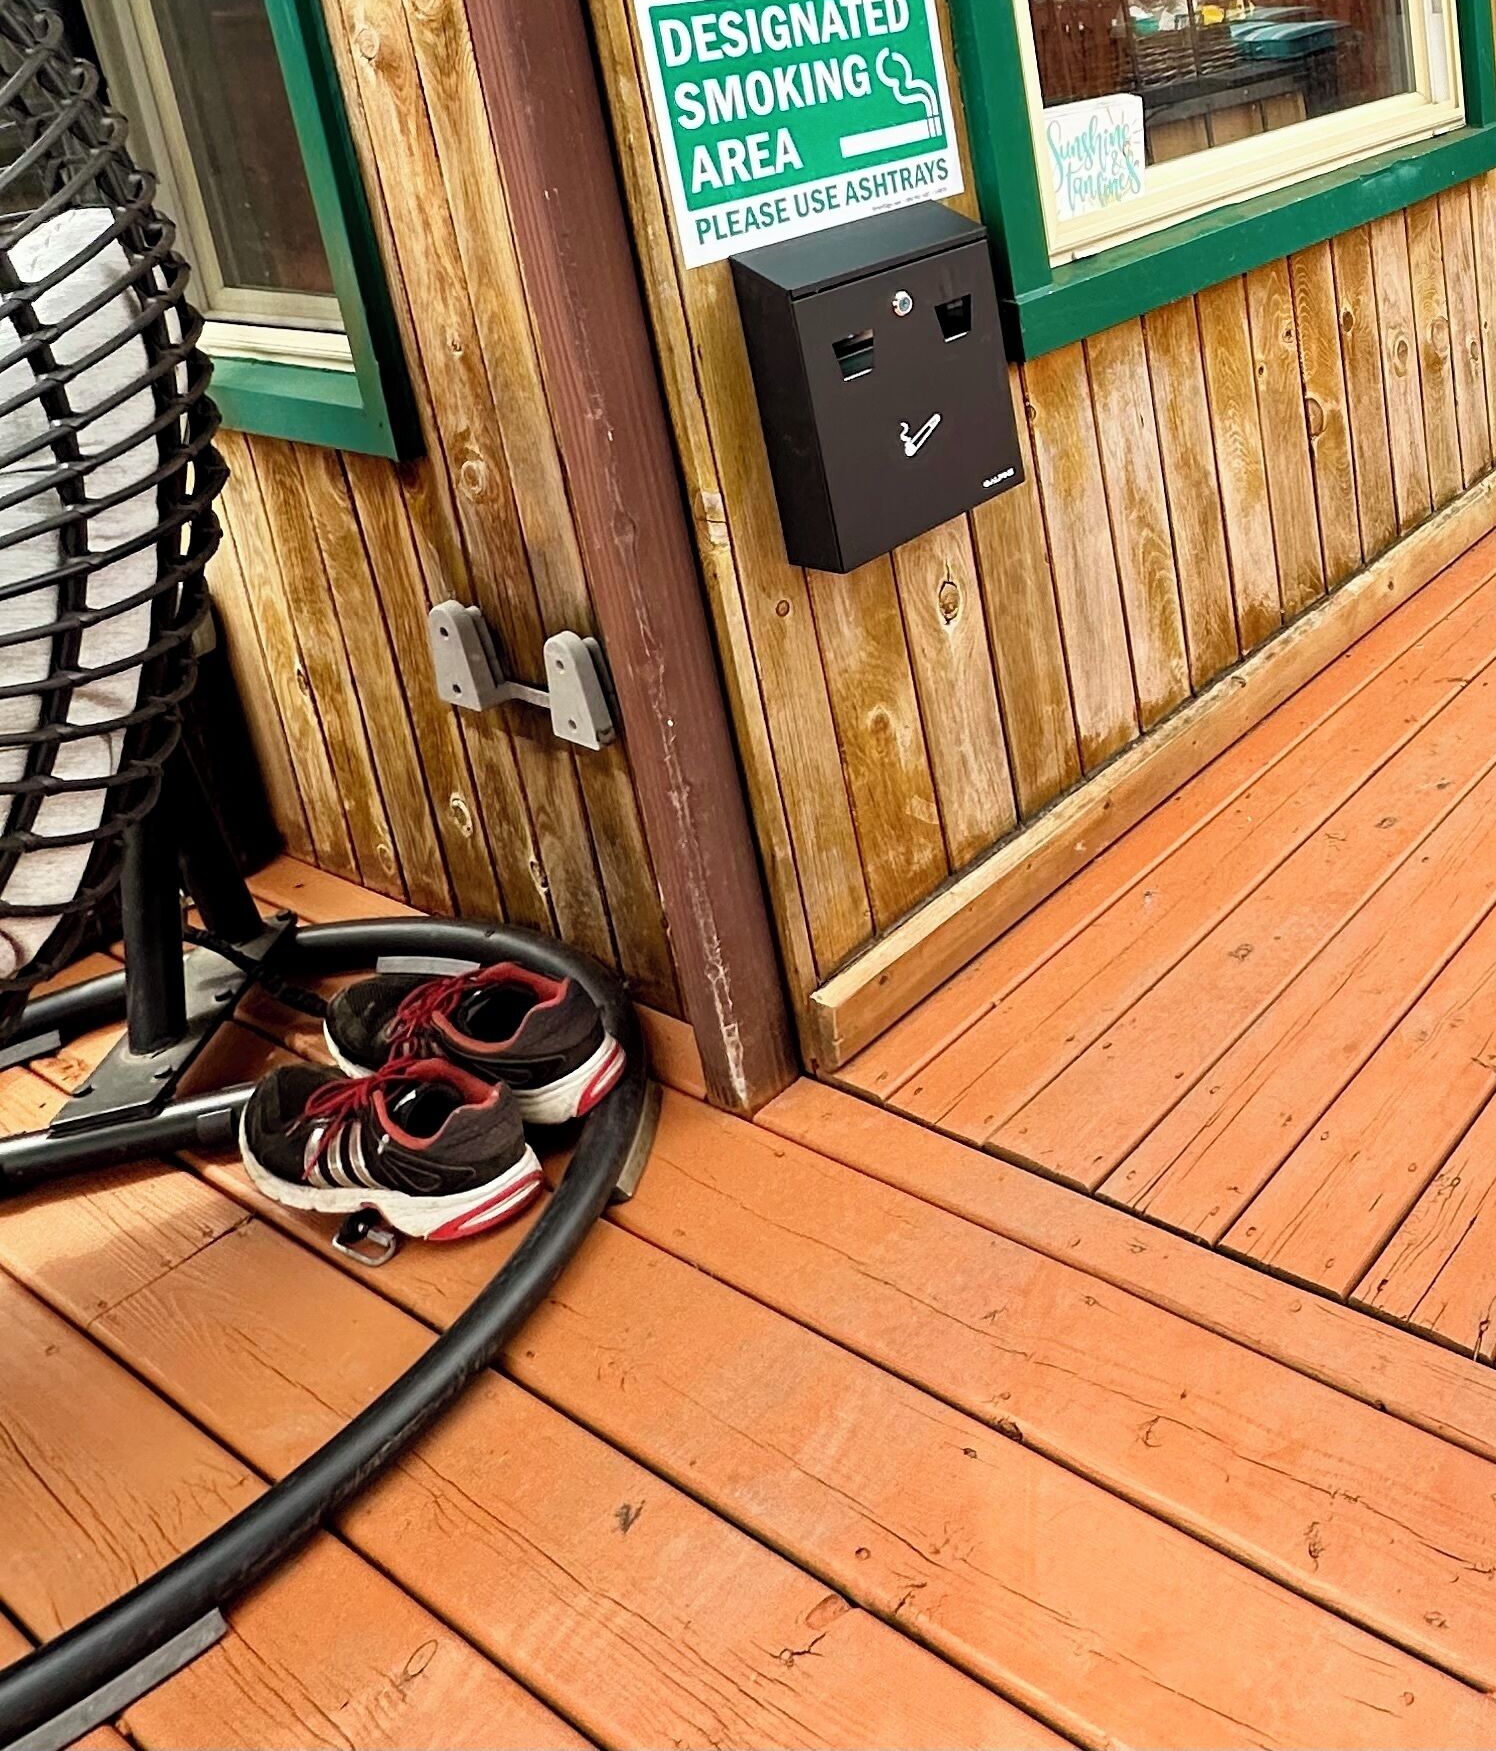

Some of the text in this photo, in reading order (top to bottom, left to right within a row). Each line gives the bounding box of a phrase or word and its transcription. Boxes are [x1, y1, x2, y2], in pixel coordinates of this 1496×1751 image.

[674, 53, 872, 130] SMOKING
[690, 127, 804, 194] AREA
[695, 197, 791, 245] PLEASE
[793, 184, 841, 218] USE
[845, 157, 949, 207] ASHTRAYS
